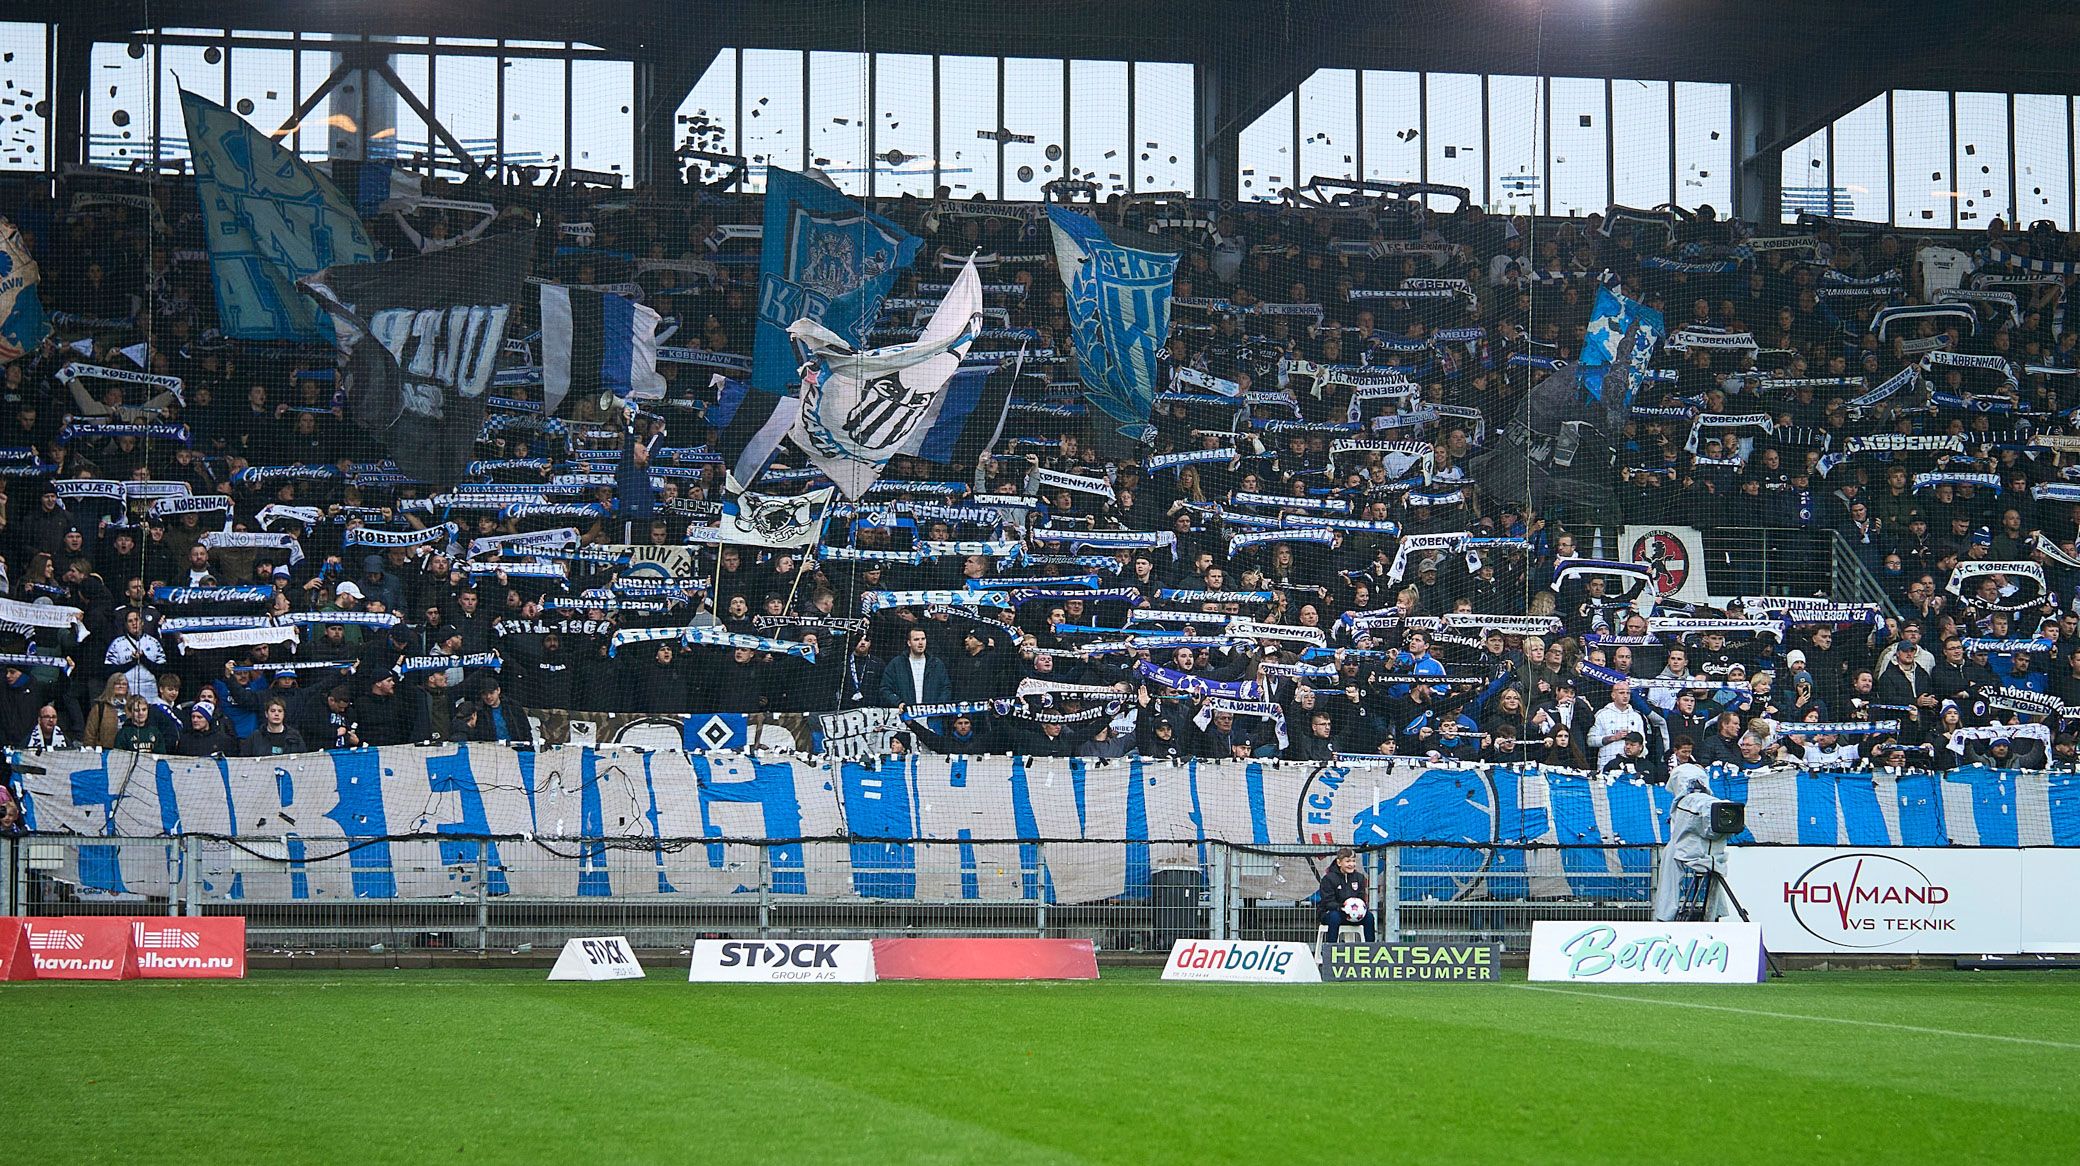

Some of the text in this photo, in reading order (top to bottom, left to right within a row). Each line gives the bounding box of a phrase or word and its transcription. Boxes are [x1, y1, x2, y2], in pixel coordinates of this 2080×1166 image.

[1697, 335, 1753, 346] KØBENHAVN
[669, 350, 731, 363] KØBENHAVN
[1935, 353, 2006, 370] F.C. KØBENHAVN
[78, 366, 179, 389] F.C. KØBENHAVN
[73, 424, 177, 434] F.C. KØBENHAVN
[1333, 440, 1431, 455] F.C. KØBENHAVN
[244, 465, 333, 482] Hovedstaden
[57, 483, 113, 493] ØNKJÆR
[1235, 492, 1346, 509] SEKTION 12
[155, 503, 172, 514] F.C.
[508, 503, 599, 518] Hovedstaden
[355, 526, 446, 543] KØBENHAVN
[513, 545, 621, 561] URBAN CREW
[1960, 563, 2043, 576] F.C. KØBENHAVN
[169, 586, 266, 603] Hovedstaden
[1017, 590, 1037, 600] F.C.
[1172, 589, 1266, 603] Hovedstaden
[554, 598, 663, 610] URBAN CREW
[1475, 617, 1554, 626] KØBENHAVN
[1790, 610, 1850, 622] KØBENHAVN
[1230, 626, 1326, 642] F.C. KØBENHAVN
[1966, 638, 2047, 652] Hovedstaden
[406, 653, 495, 669] URBAN CREW
[907, 703, 957, 717] URBAN
[1013, 706, 1102, 723] F.C. KØBENHAVN
[1850, 918, 1956, 931] VS TEKNIK
[720, 943, 840, 967] STOCK
[1177, 942, 1294, 974] danbolig
[1331, 946, 1491, 964] HEATSAVE
[772, 972, 836, 980] GROUP A/S
[1332, 966, 1490, 979] VARMEPUMPER
